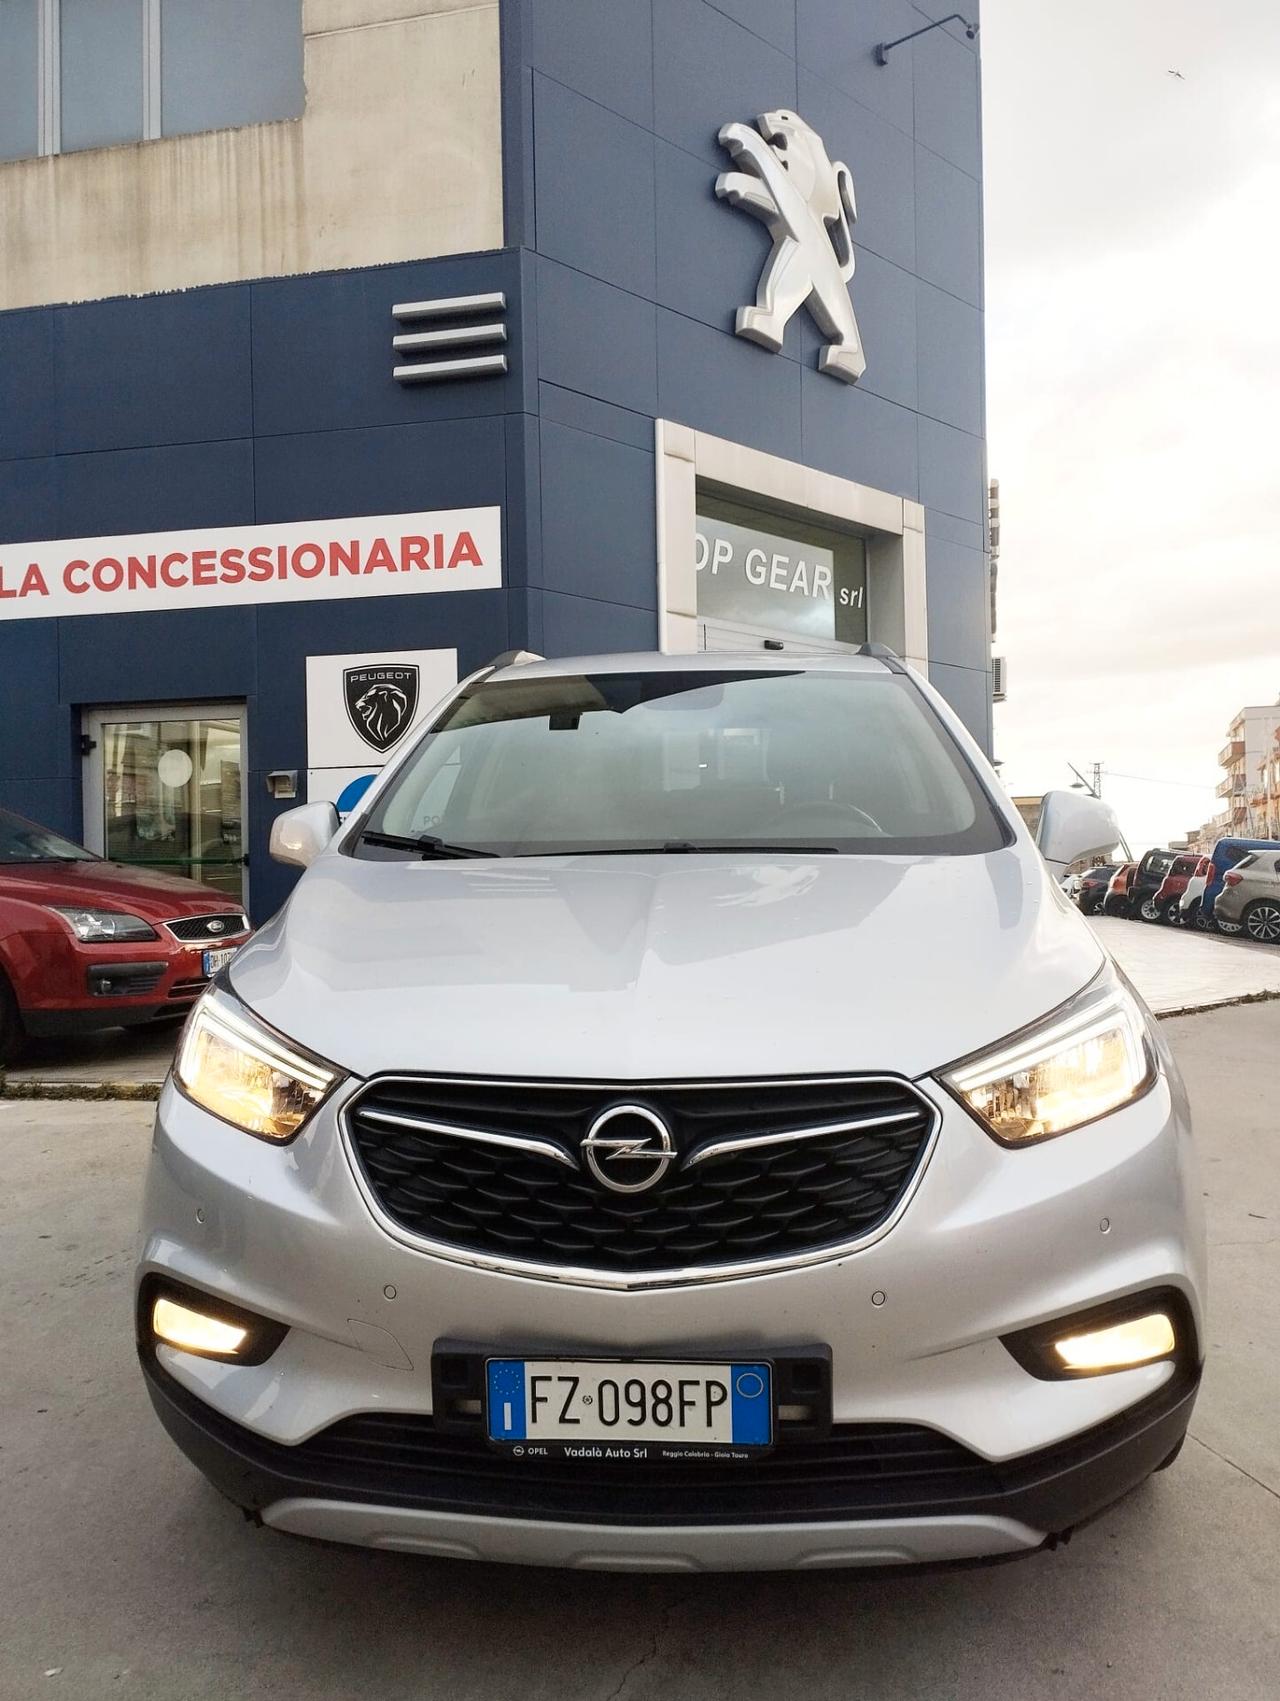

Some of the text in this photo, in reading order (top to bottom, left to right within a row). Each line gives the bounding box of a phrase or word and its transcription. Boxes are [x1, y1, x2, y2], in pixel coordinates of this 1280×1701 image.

[63, 531, 483, 594] CONCESSIONARIA
[745, 548, 832, 601] GEAR
[839, 586, 864, 608] srl
[350, 671, 412, 683] PEUGEOT
[527, 1447, 548, 1456] OPEL
[563, 1446, 648, 1459] Vadalà Auto Srl
